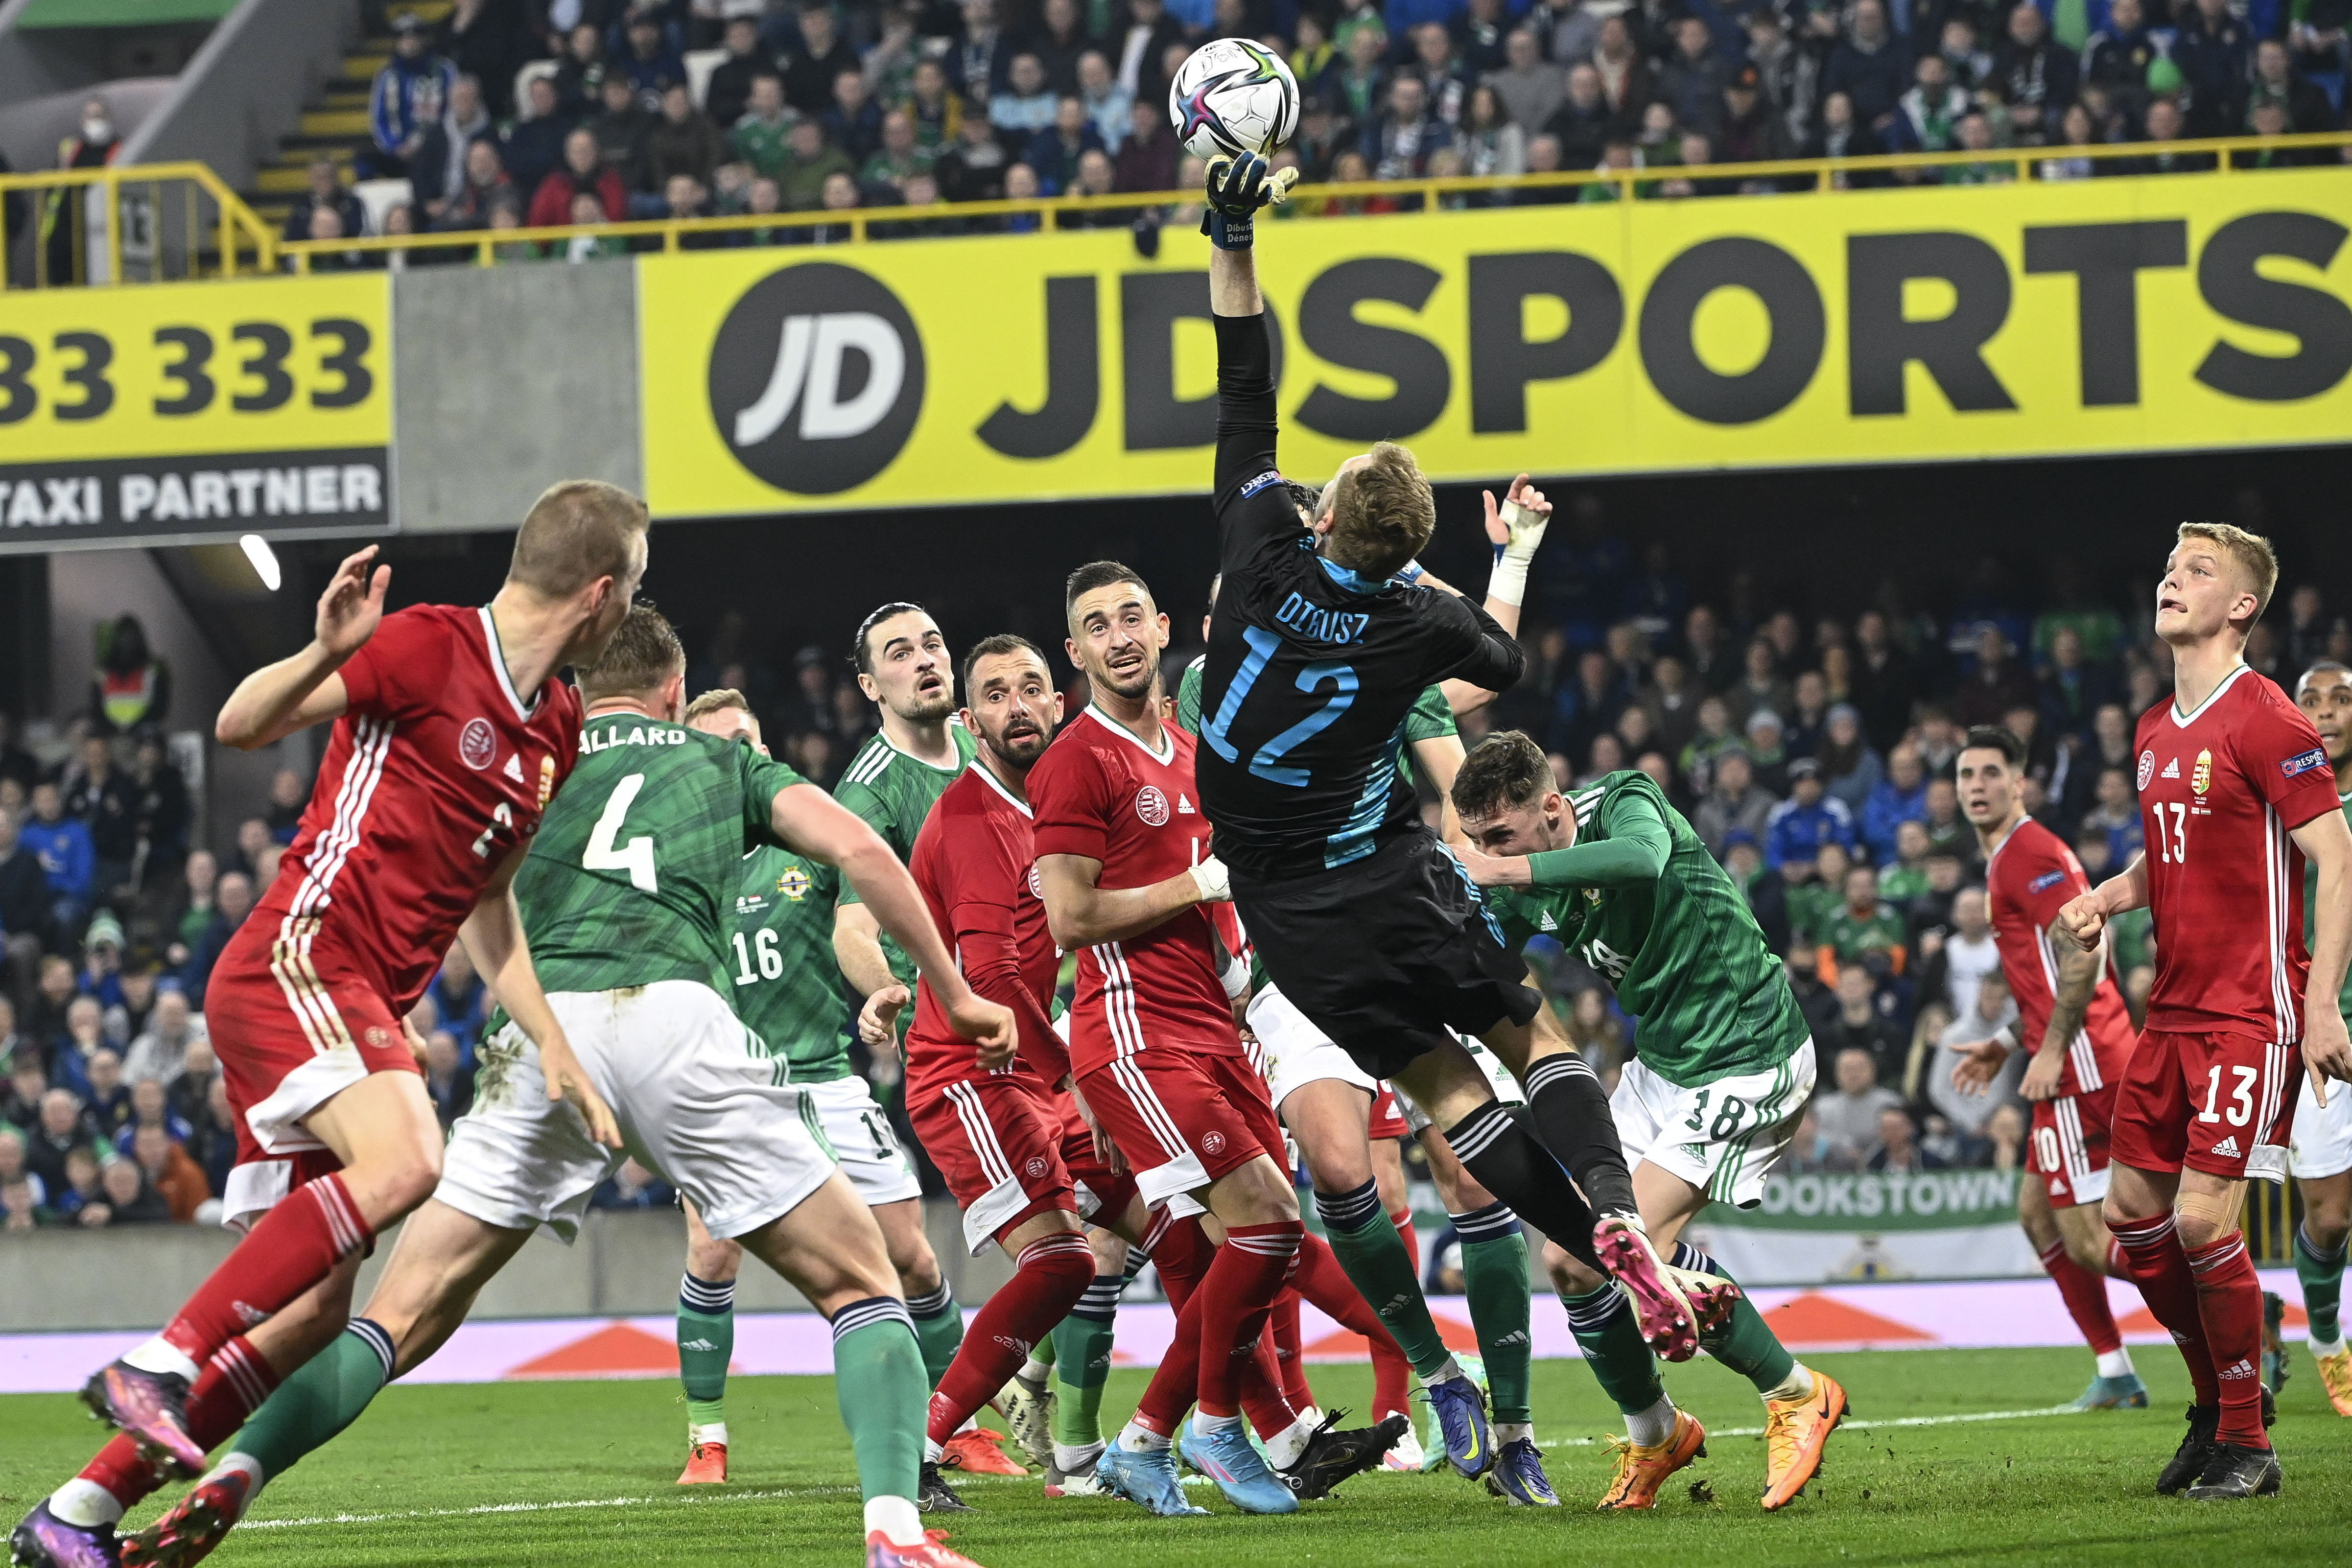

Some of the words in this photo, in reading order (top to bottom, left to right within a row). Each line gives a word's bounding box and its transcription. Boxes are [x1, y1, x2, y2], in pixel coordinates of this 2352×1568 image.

[1227, 232, 1252, 243] Dénes
[153, 318, 374, 416] 333
[734, 310, 906, 446] JD
[119, 464, 382, 522] PARTNER
[1241, 472, 1277, 494] RESPECT
[1200, 624, 1360, 787] 12
[2295, 752, 2324, 769] RESPECT
[582, 772, 658, 893] 4
[2153, 802, 2186, 864] 13
[732, 927, 783, 986] 16
[1685, 1089, 1746, 1141] 18
[2198, 1065, 2258, 1126] 13
[2211, 1147, 2241, 1158] adidas
[1736, 1171, 2013, 1216] OOKSTOWN
[2218, 1369, 2257, 1380] adidas
